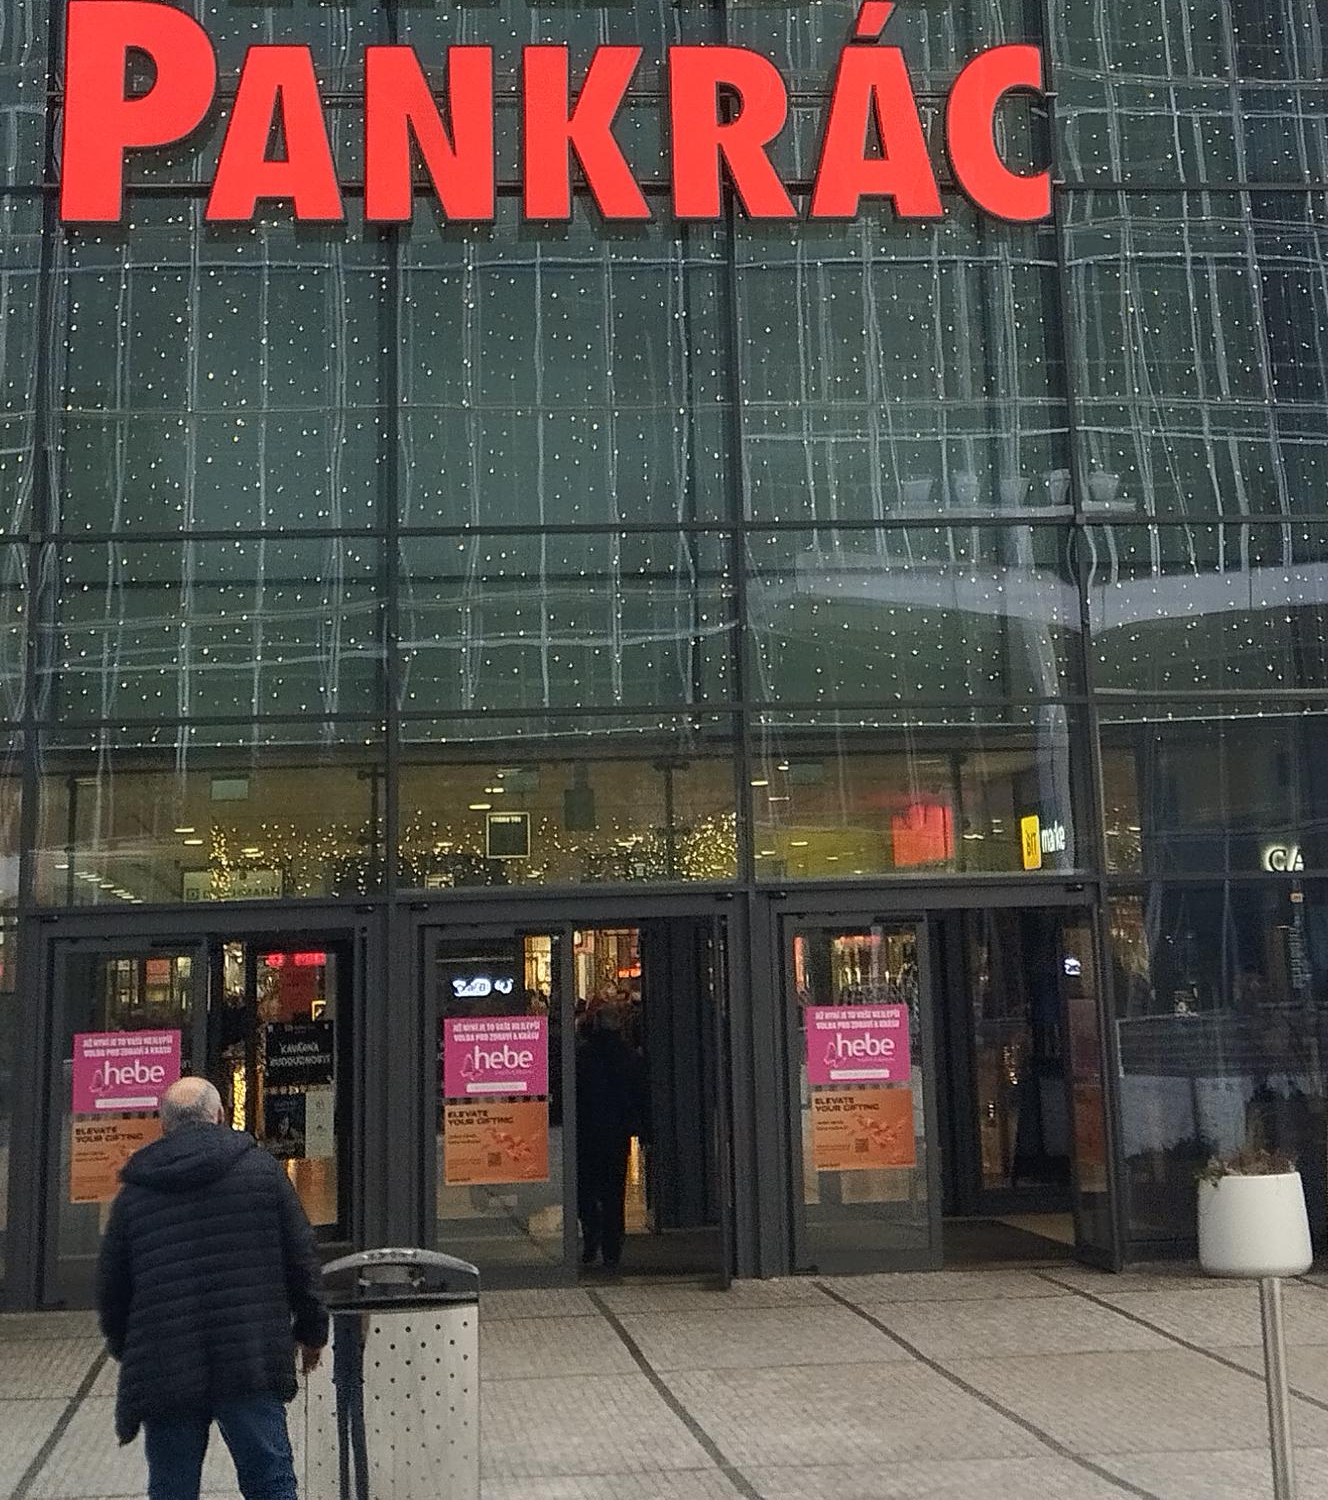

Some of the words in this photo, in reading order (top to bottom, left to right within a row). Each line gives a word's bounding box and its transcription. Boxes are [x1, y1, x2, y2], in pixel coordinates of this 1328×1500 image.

[59, 0, 1052, 223] PANKRÁC
[836, 1032, 895, 1057] hebe
[474, 1044, 533, 1070] hebe
[104, 1060, 165, 1085] hebe
[815, 1097, 854, 1105] ELEVATE
[448, 1110, 488, 1118] ELEVATE
[448, 1118, 474, 1126] YOUR
[76, 1126, 117, 1135] ELEVATE
[75, 1134, 103, 1143] YOUR
